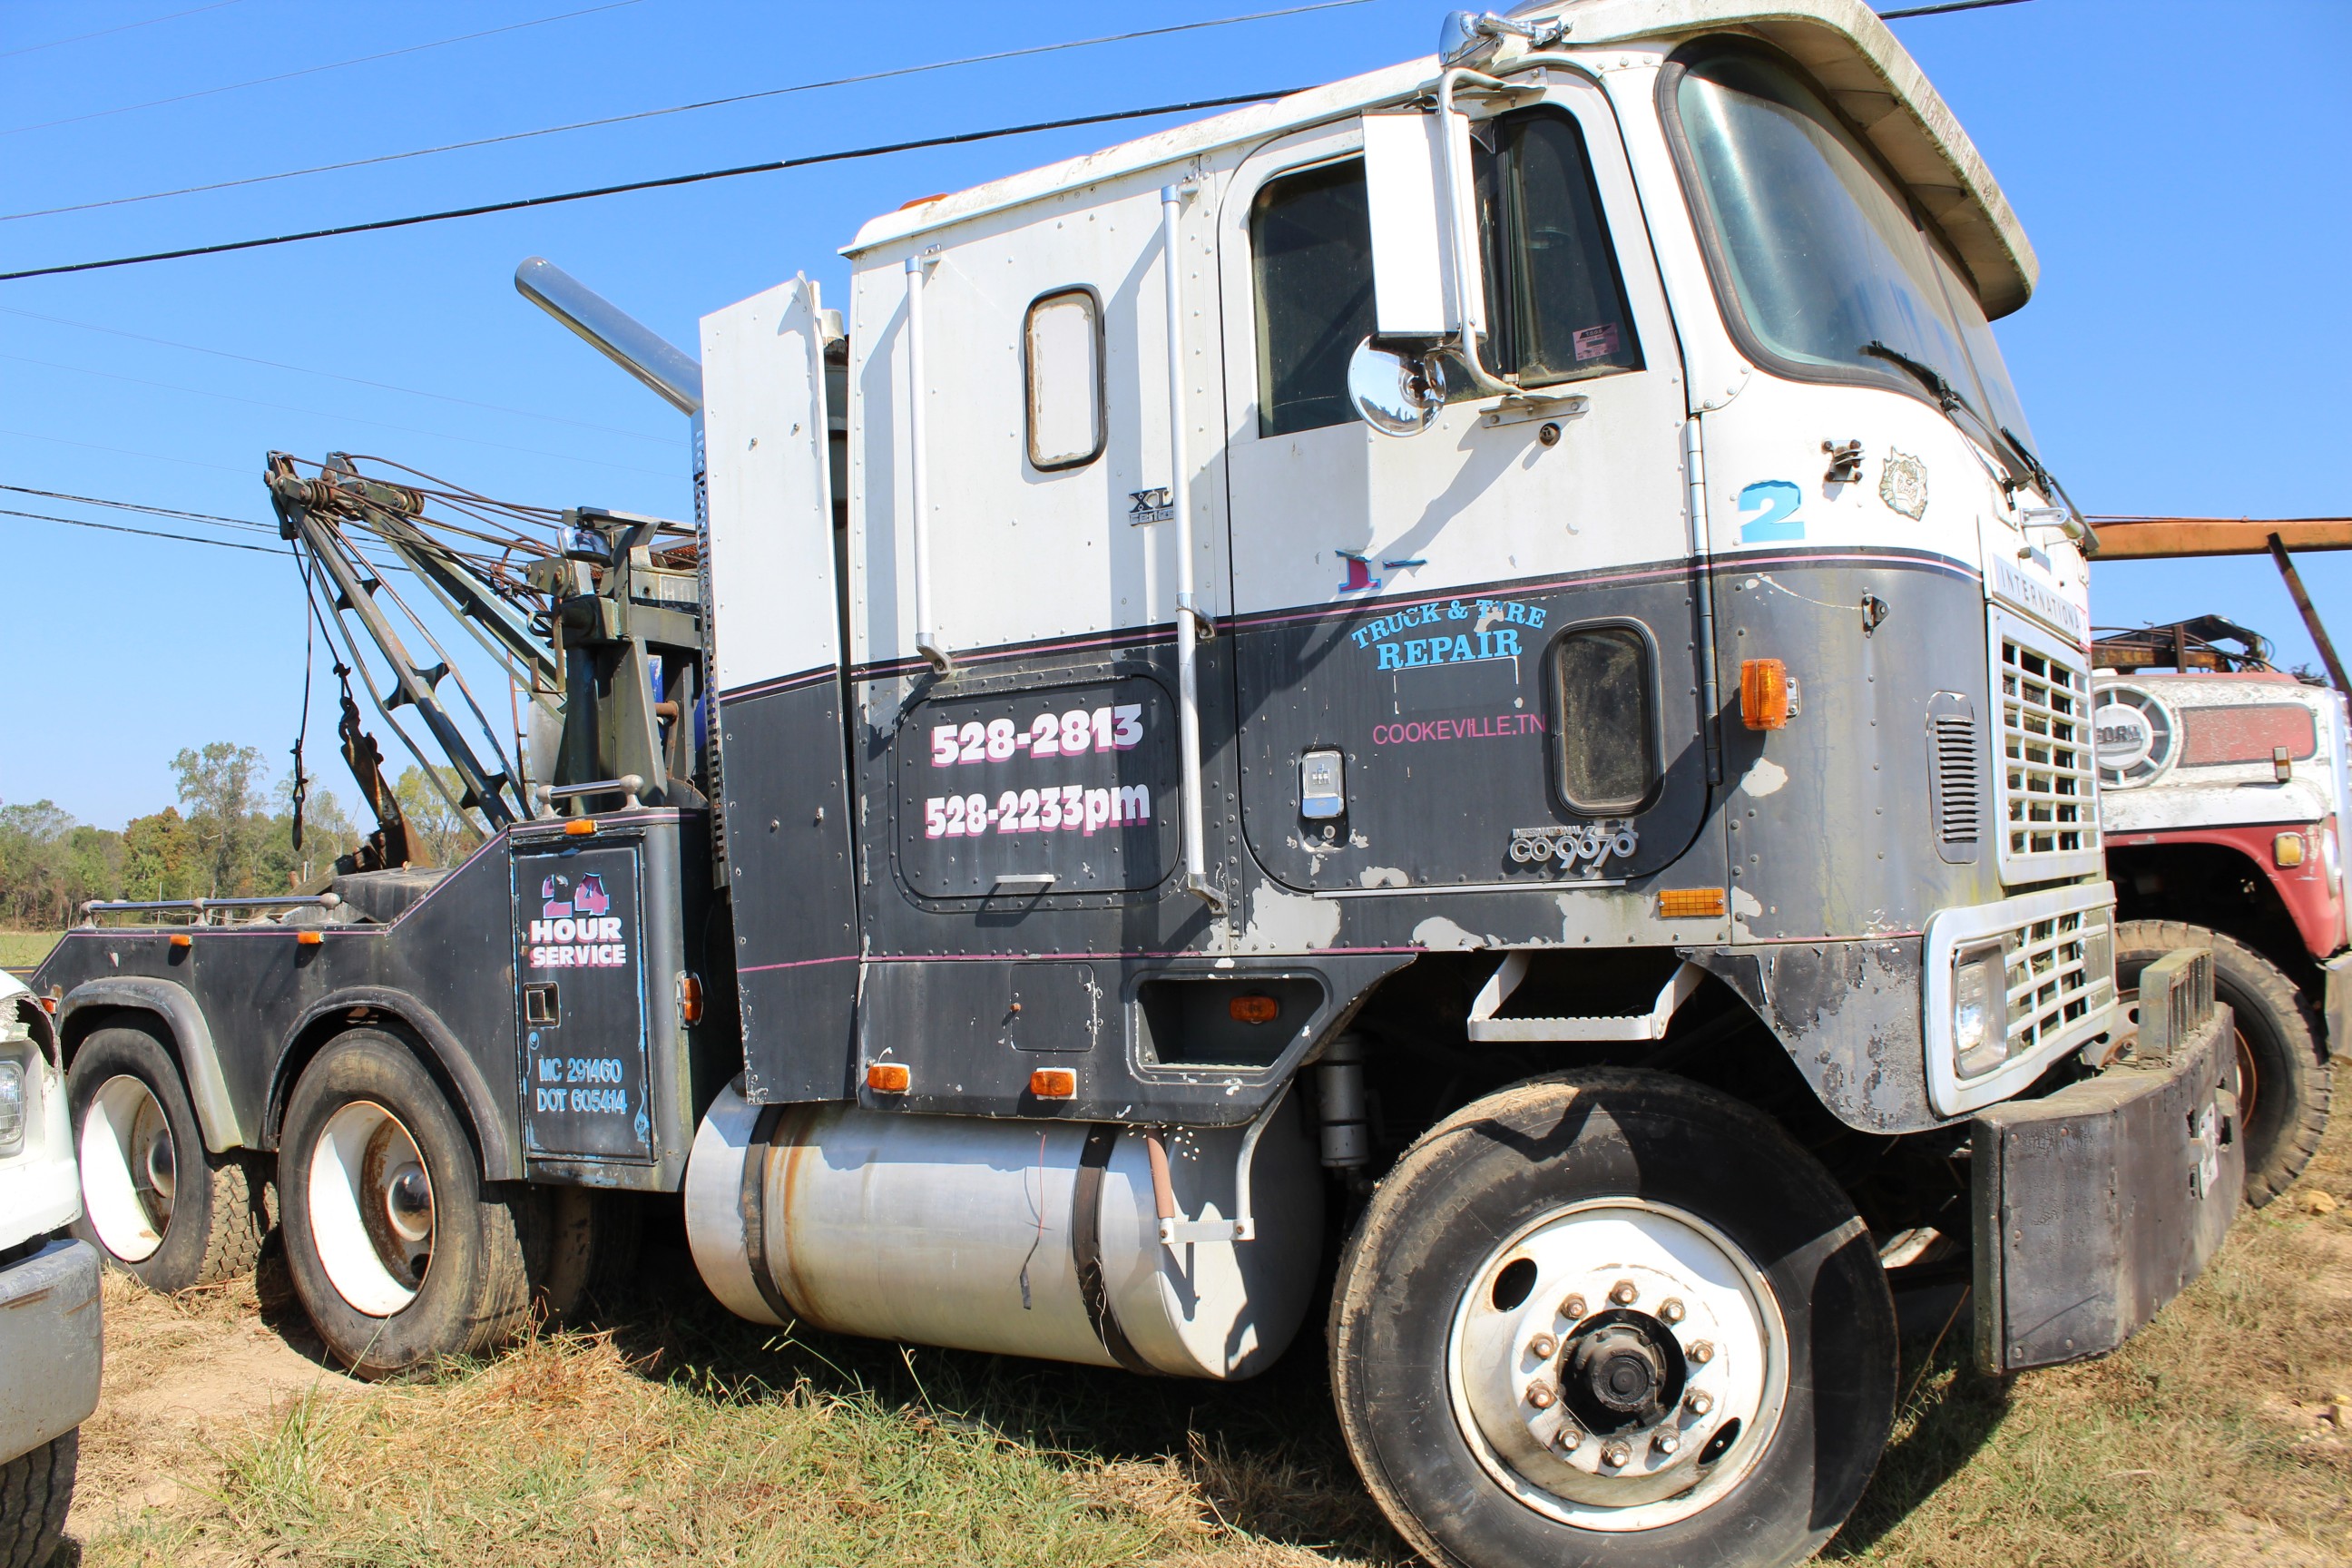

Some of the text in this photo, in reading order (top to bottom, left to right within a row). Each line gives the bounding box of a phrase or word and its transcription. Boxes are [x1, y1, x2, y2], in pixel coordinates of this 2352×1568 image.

[1129, 486, 1173, 513] XL
[1738, 479, 1805, 544] 2
[2001, 565, 2081, 631] INTERNATIONA
[1351, 600, 1546, 650] TRUCK & TRE
[1377, 629, 1522, 670] REPAIR
[931, 703, 1143, 768] 528-2813
[1373, 714, 1546, 745] COOKEVILLE.TN
[925, 783, 1151, 839] 528-2233pm
[1510, 826, 1637, 869] CO-9670
[1513, 825, 1582, 838] INTERNATIONAL
[530, 917, 622, 944] HOUR
[530, 945, 626, 967] SERVICE
[538, 1057, 622, 1083] MC 291460
[537, 1088, 628, 1114] DOT 605414
